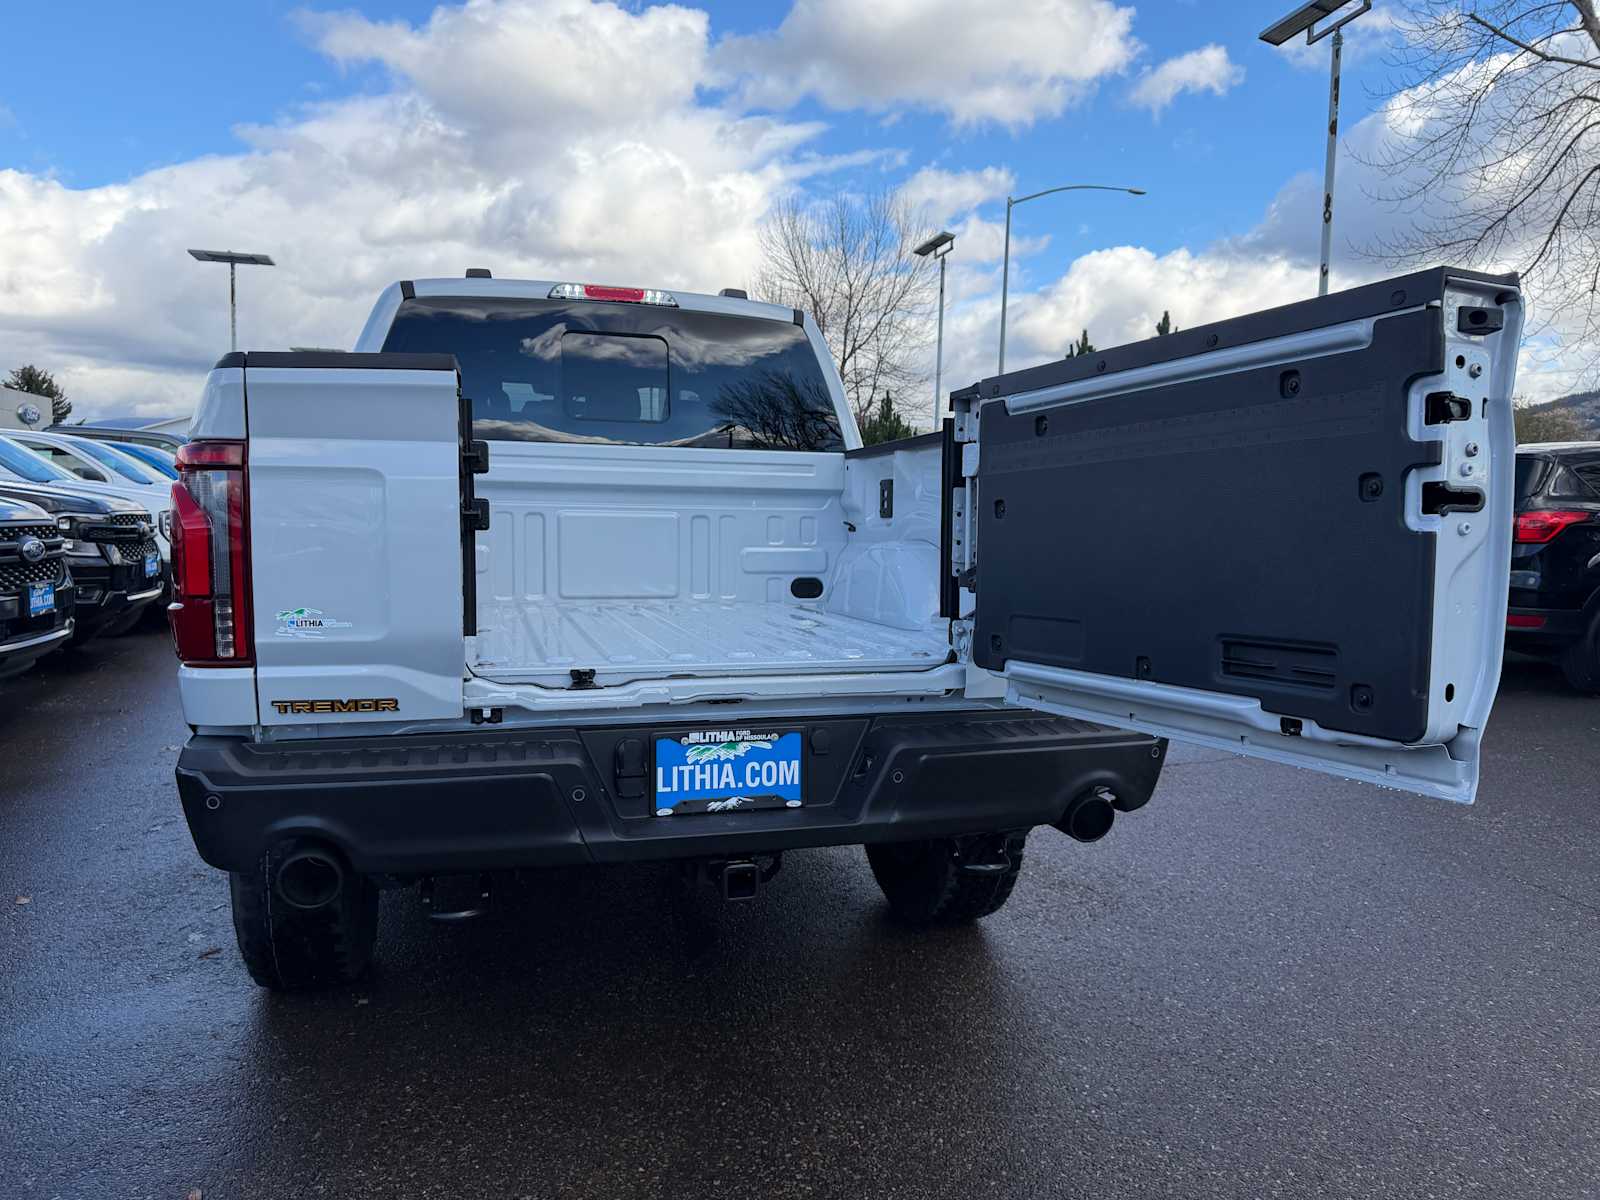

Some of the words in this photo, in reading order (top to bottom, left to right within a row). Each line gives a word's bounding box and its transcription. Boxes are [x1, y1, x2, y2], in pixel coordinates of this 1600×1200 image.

[295, 619, 324, 627] LITHIA
[271, 698, 401, 714] TREMOR
[699, 731, 736, 743] LITHIA
[743, 733, 771, 741] MISSOULA
[656, 760, 800, 793] LITHIA.COM
